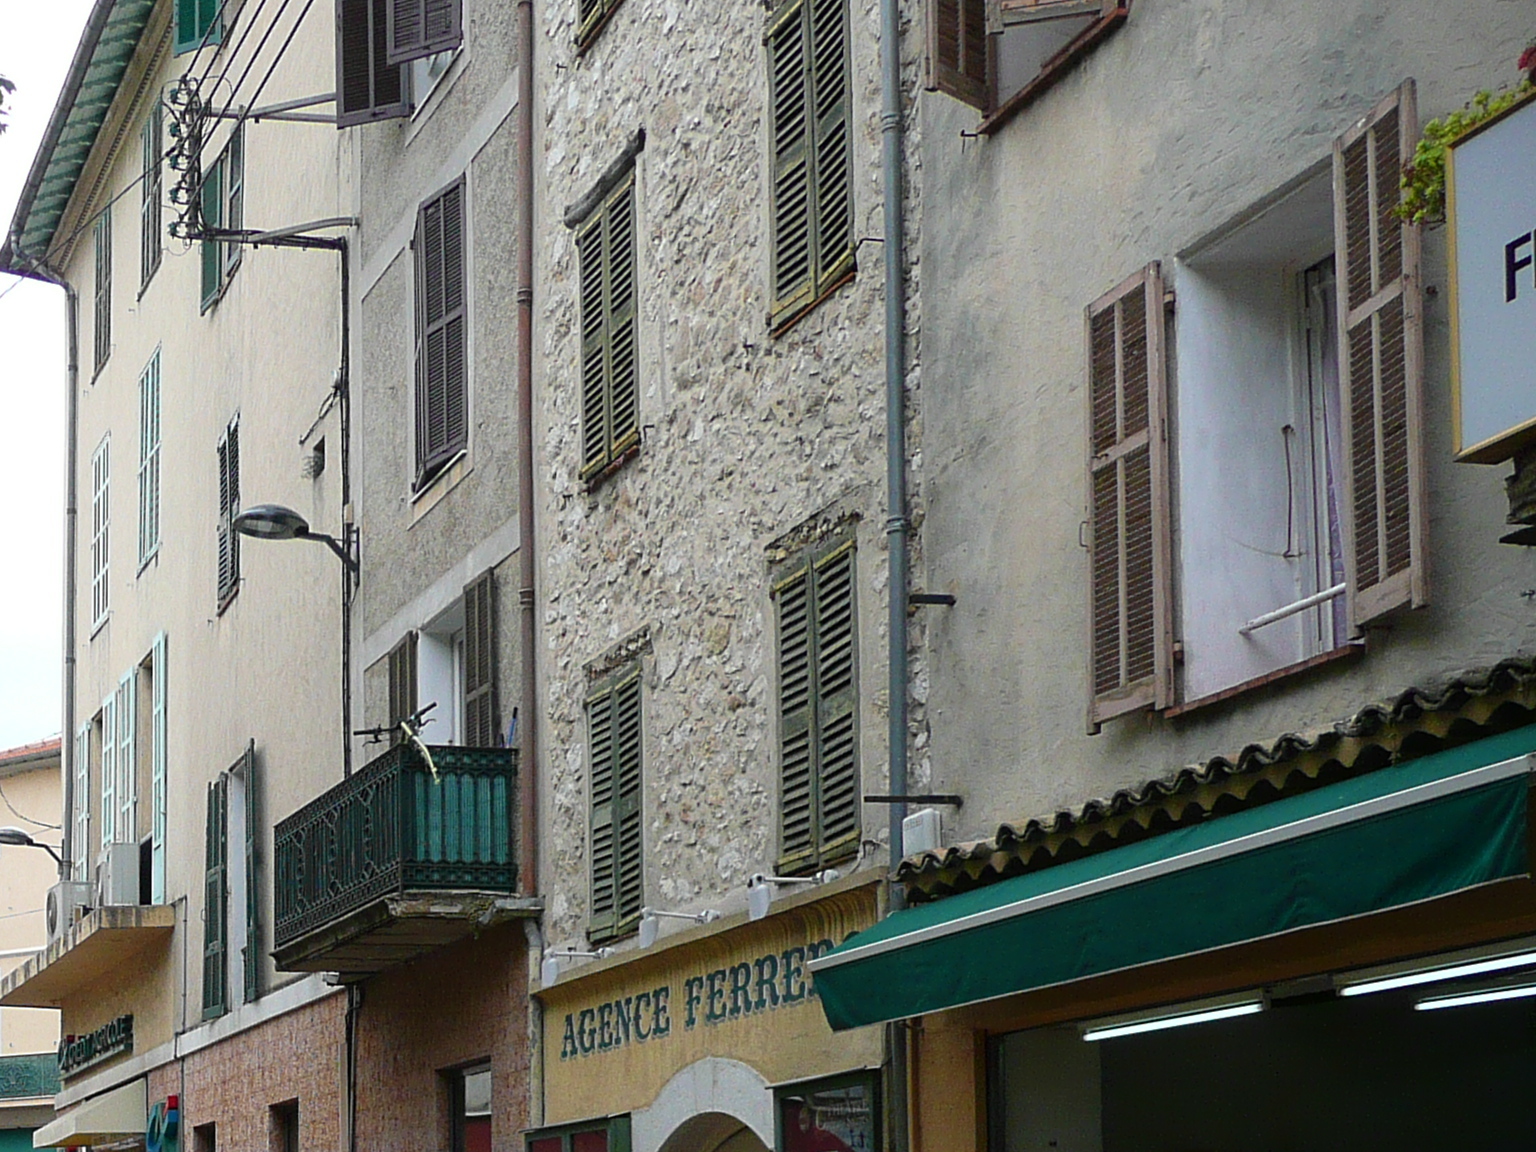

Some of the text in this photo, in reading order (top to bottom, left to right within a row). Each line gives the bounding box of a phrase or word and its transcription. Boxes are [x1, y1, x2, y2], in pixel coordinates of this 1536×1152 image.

[1505, 229, 1536, 303] F
[560, 930, 860, 1060] AGENCE FERRE
